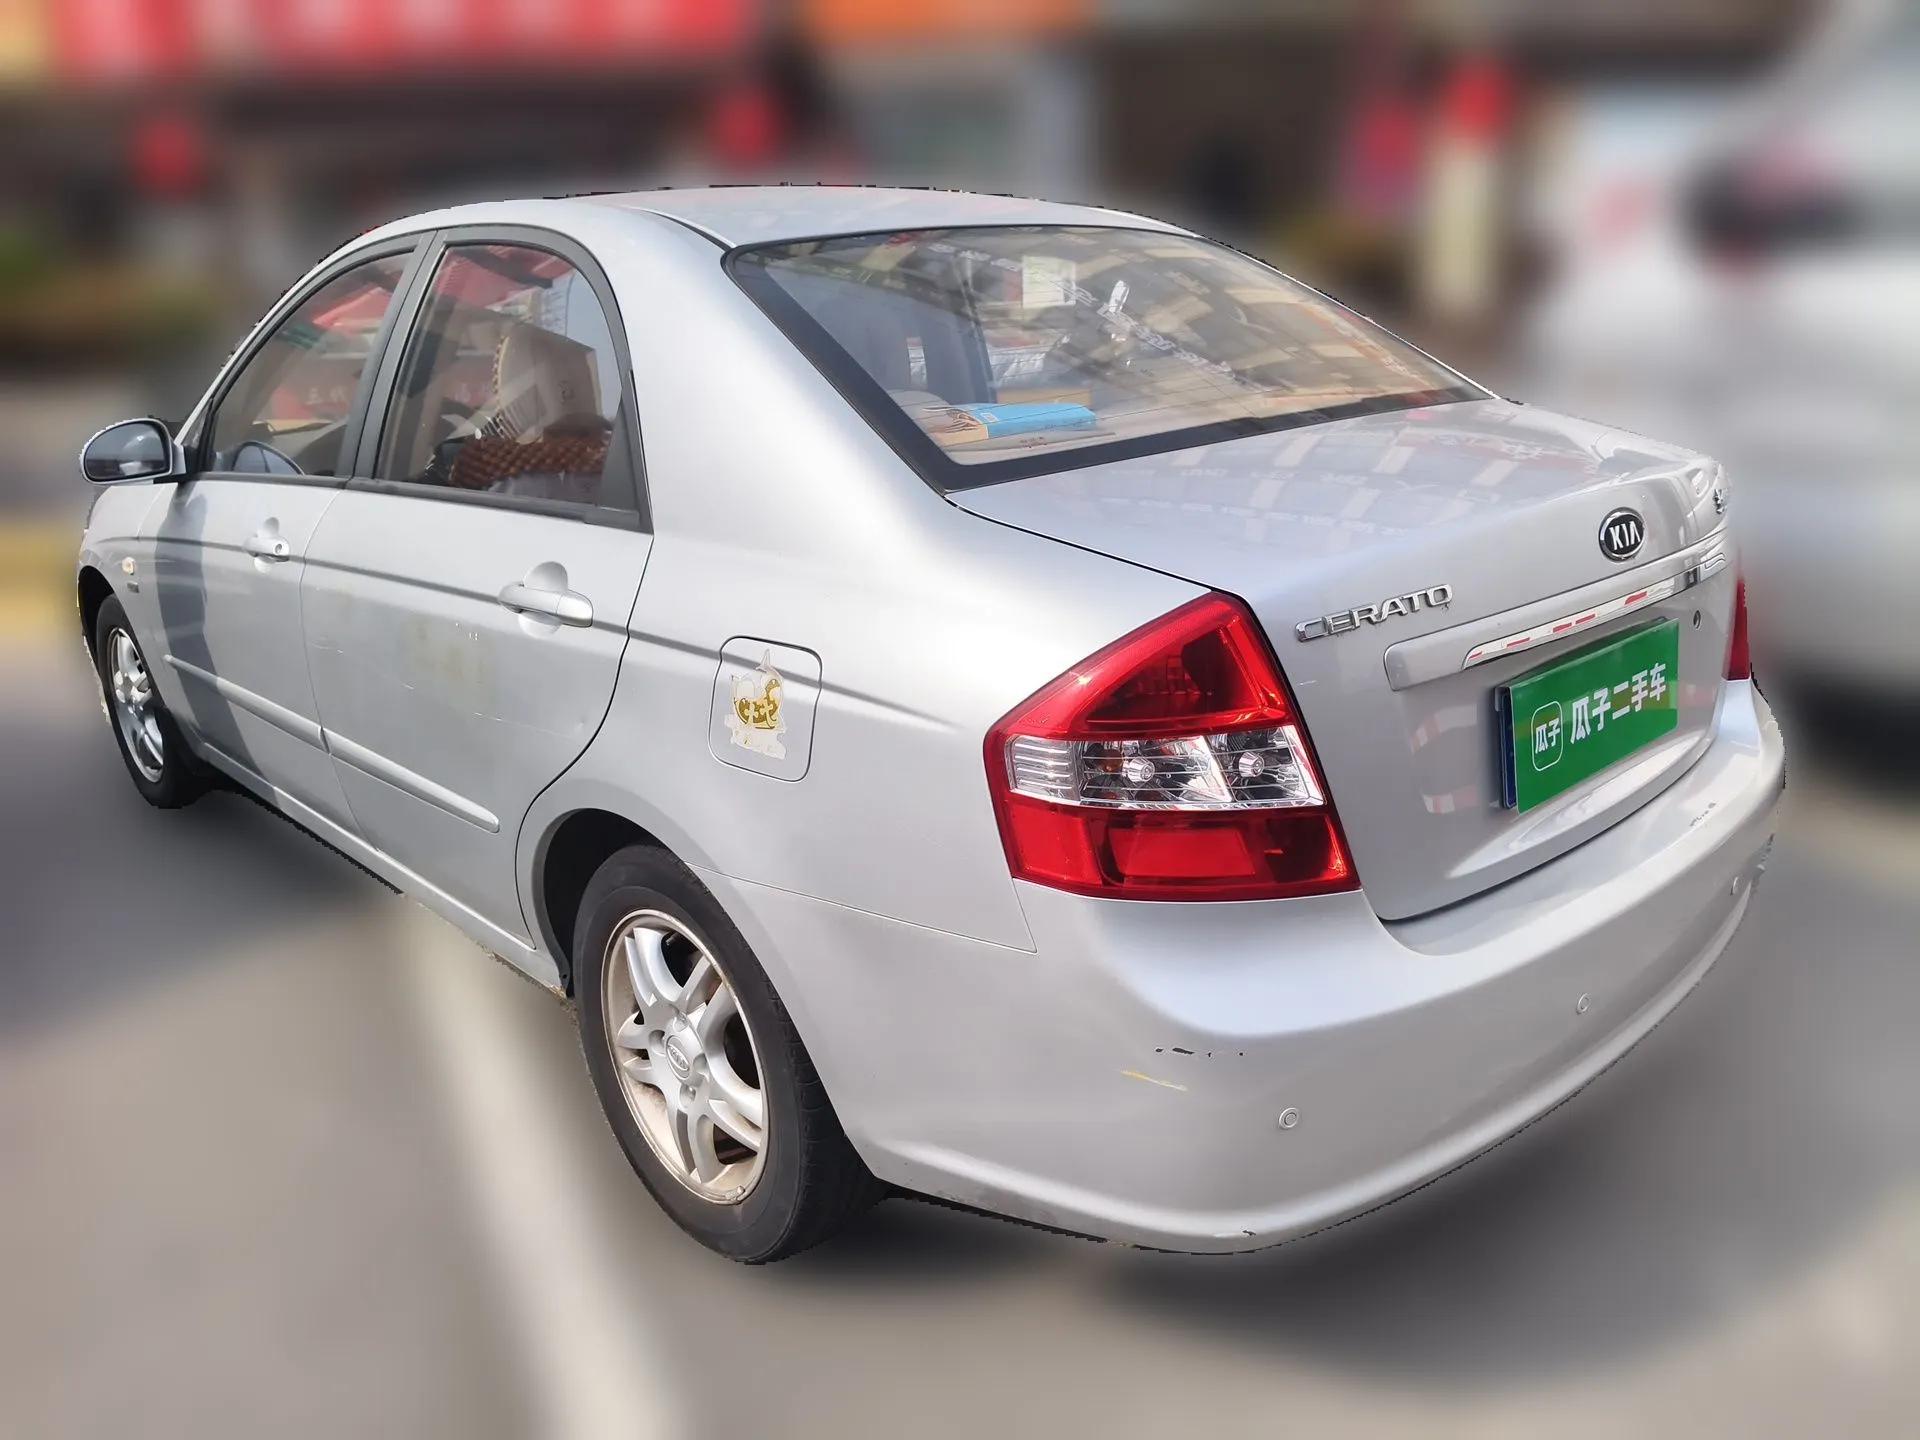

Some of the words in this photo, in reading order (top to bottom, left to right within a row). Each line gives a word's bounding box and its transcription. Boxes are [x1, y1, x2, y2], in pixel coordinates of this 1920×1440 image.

[1609, 520, 1641, 551] KIA
[1296, 584, 1453, 642] CERATO
[1570, 662, 1666, 744] 瓜子二手车
[1535, 717, 1561, 755] 瓜子
